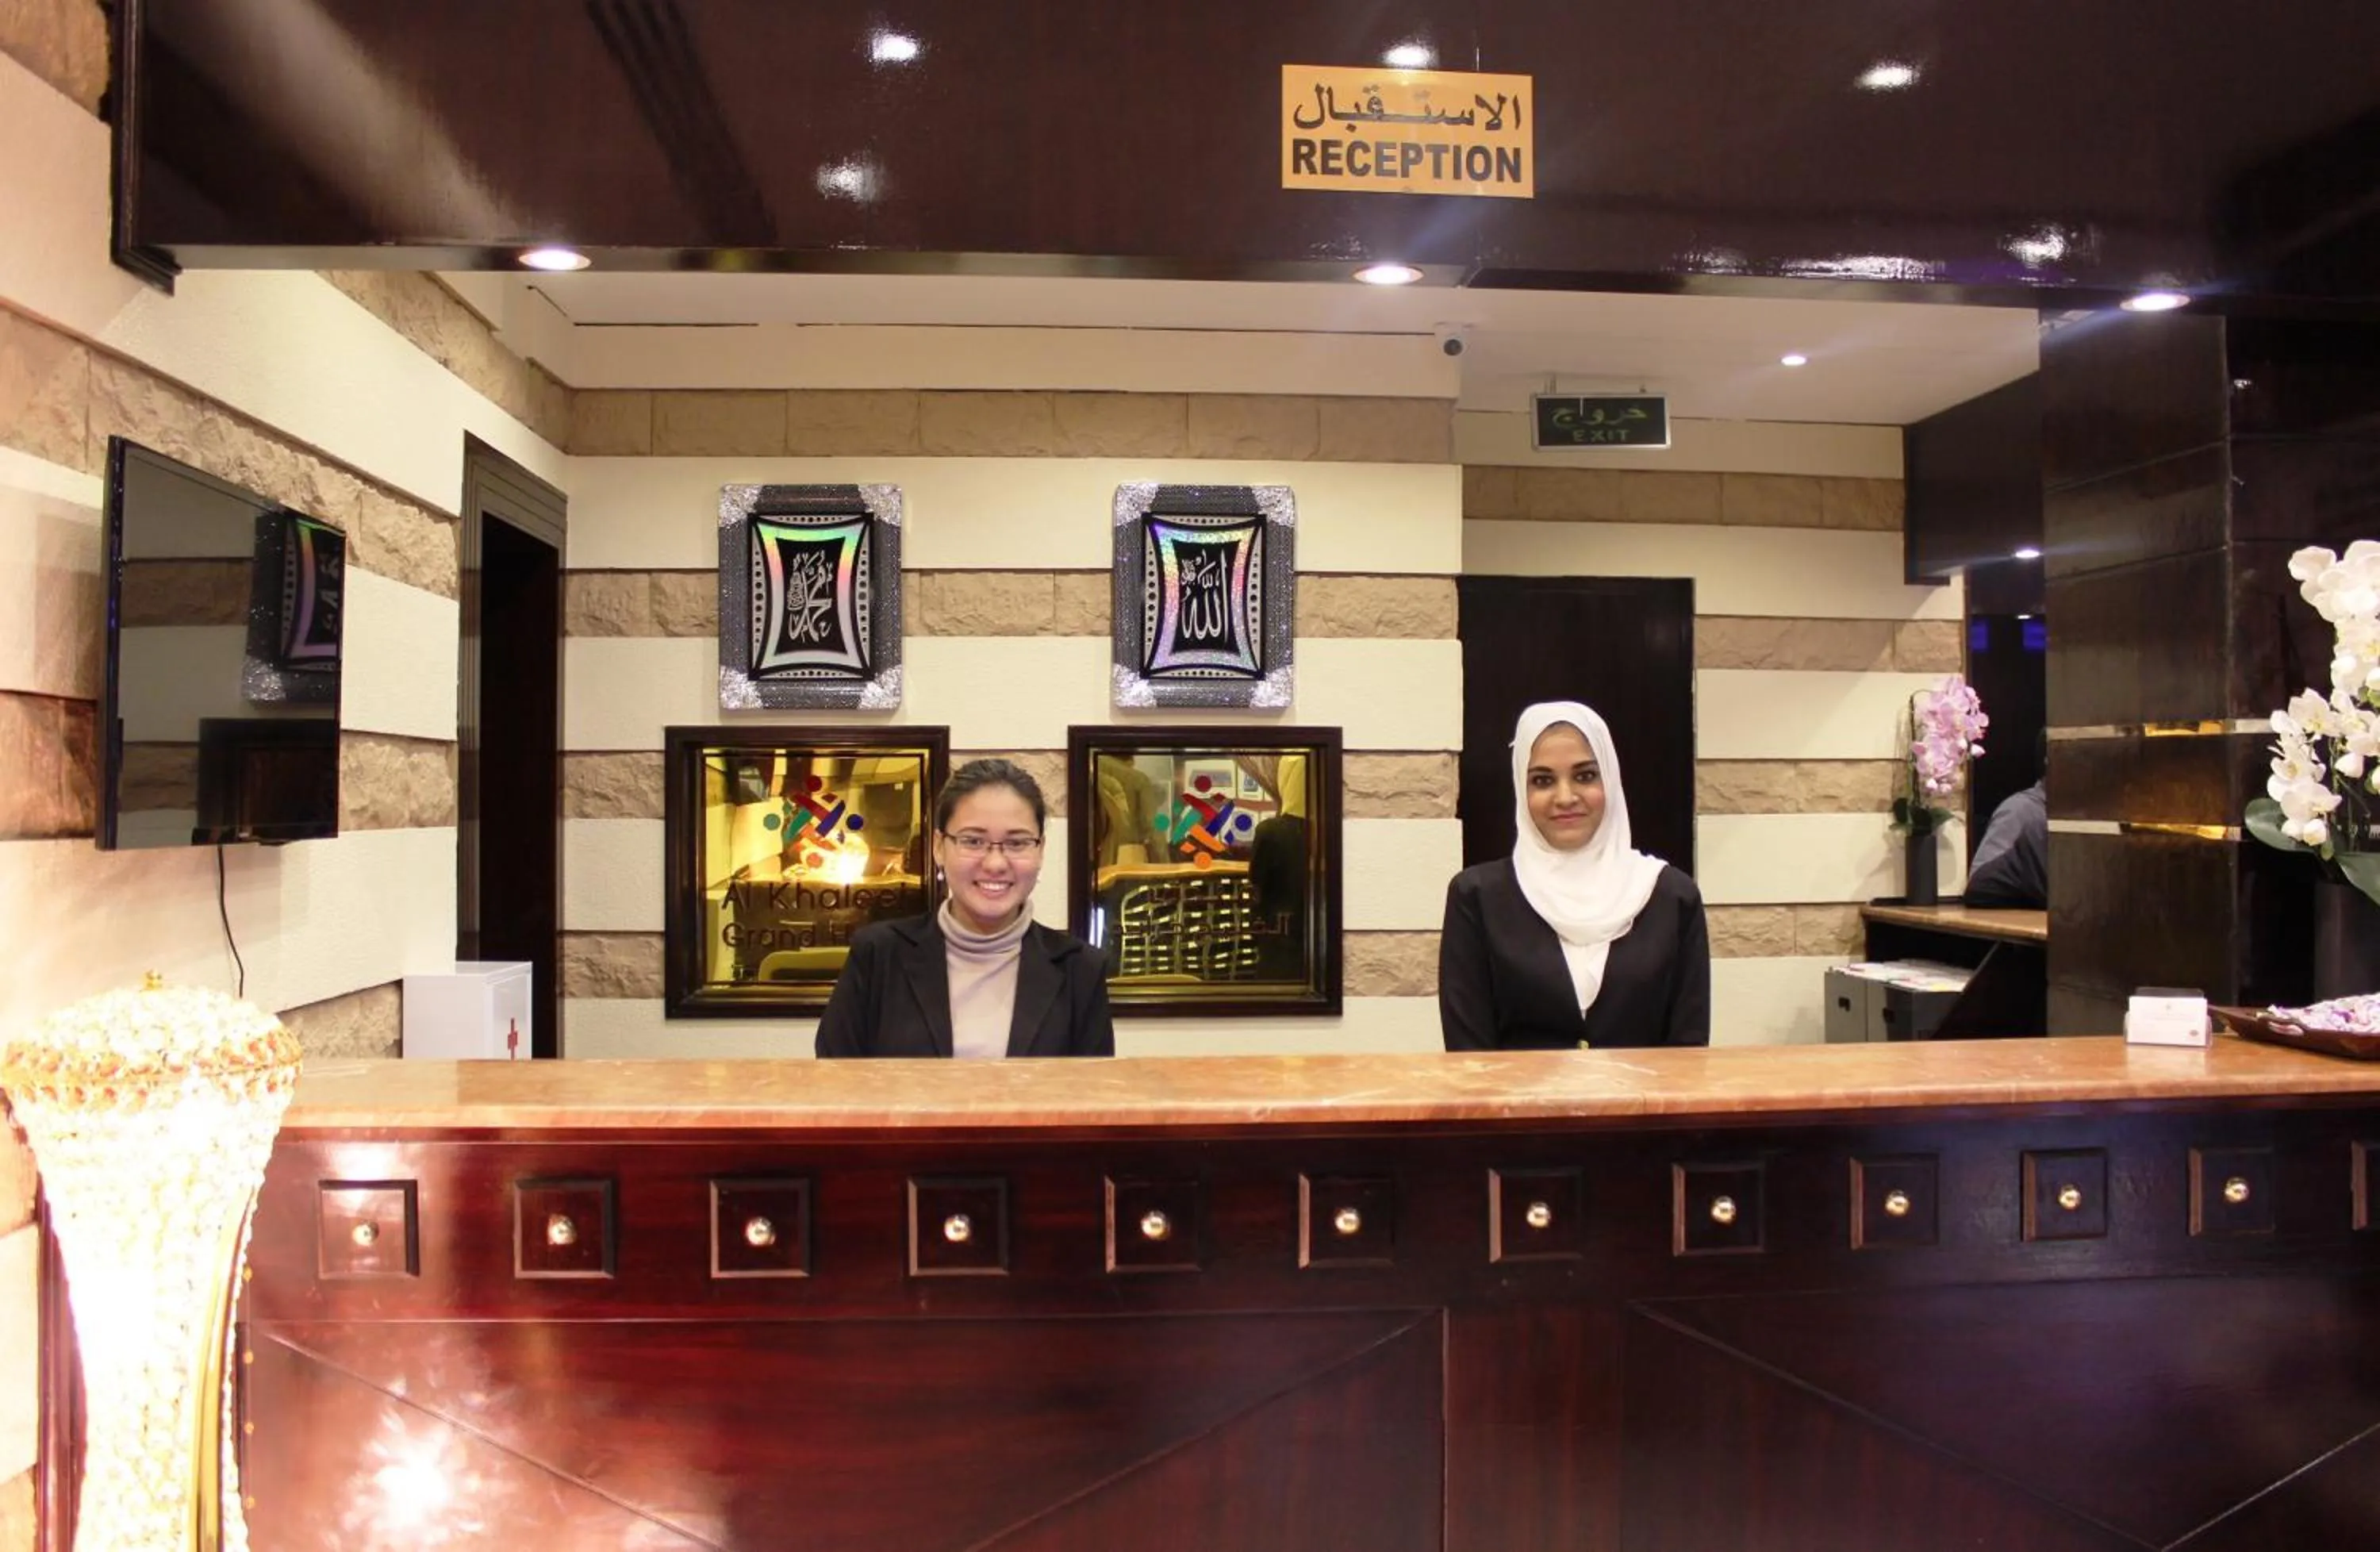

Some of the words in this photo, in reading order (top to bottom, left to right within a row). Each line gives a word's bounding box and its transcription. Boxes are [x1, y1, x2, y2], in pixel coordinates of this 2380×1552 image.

[1293, 83, 1522, 133] الاستقبال
[1292, 138, 1522, 183] RECEPTION
[1572, 429, 1630, 442] EXIT
[722, 879, 751, 910] Al
[723, 921, 816, 948] Grand
